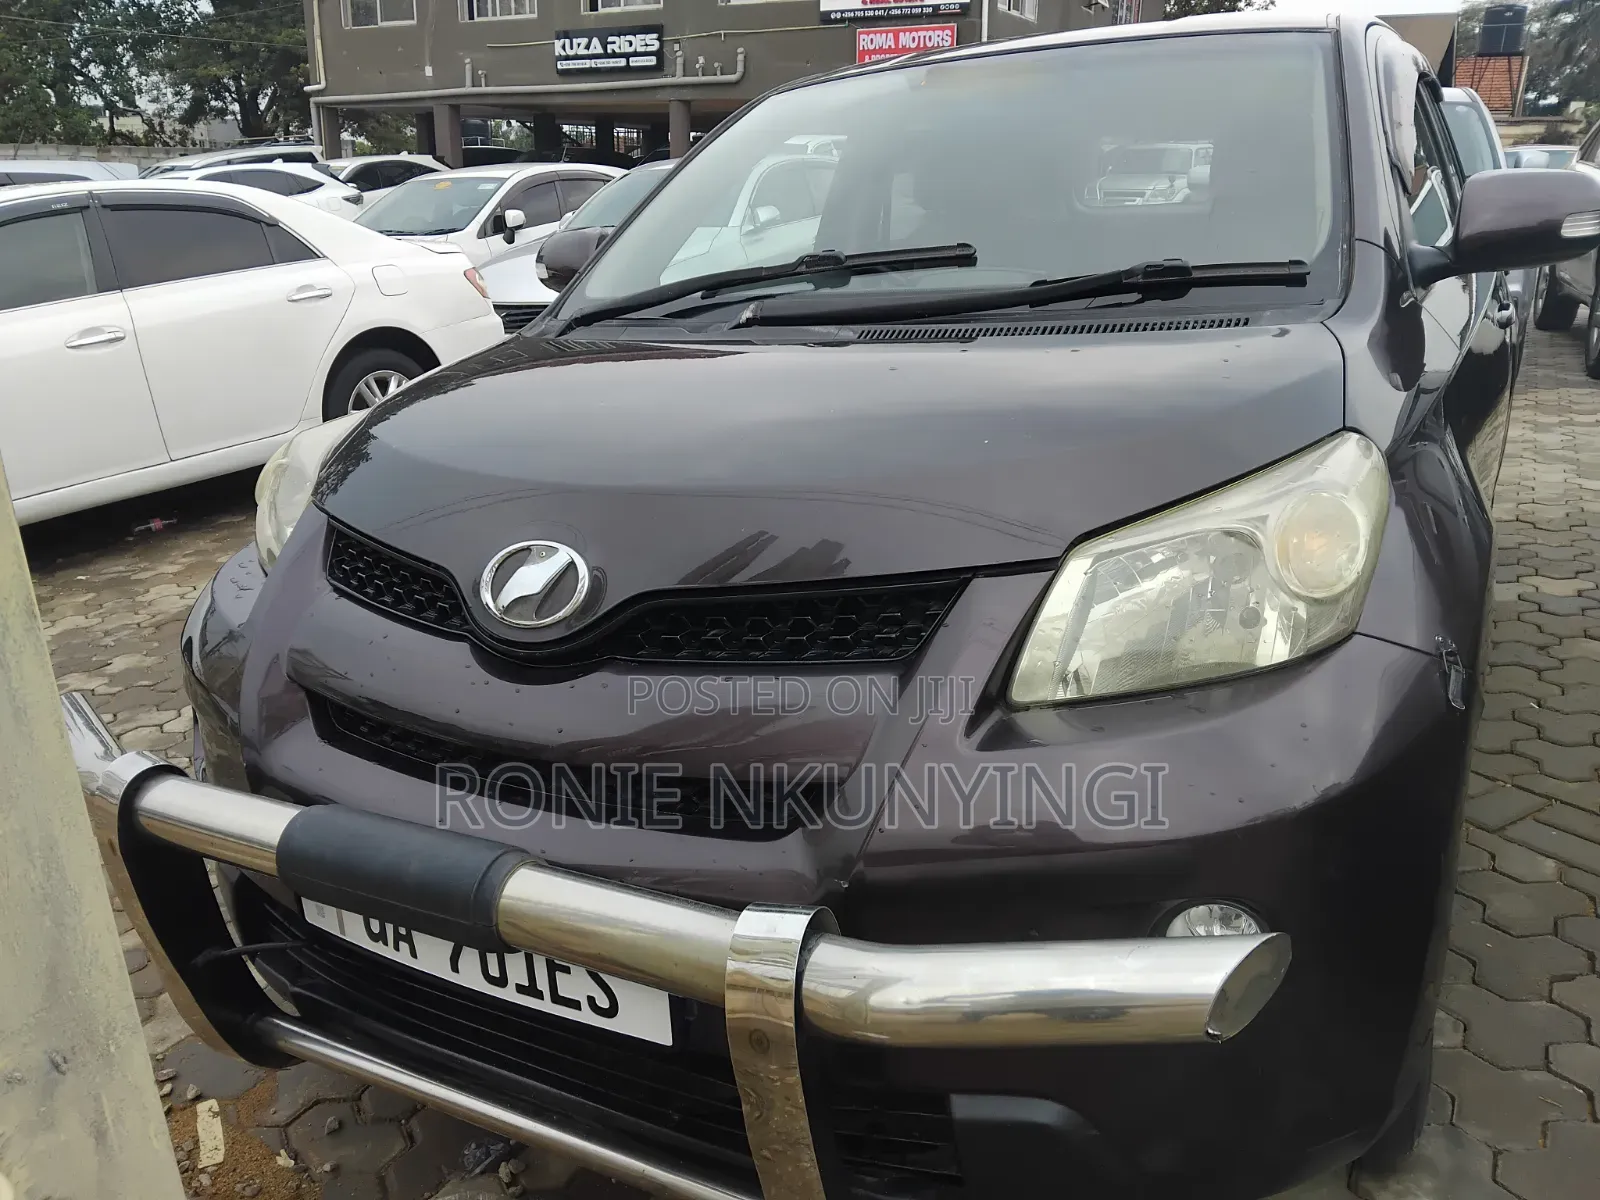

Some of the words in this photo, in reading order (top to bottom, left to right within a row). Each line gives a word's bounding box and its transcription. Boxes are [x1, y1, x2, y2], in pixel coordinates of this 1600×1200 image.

[554, 37, 604, 56] KUZA
[607, 33, 660, 53] RIDES
[860, 32, 895, 50] ROMA
[899, 29, 952, 49] MOTORS
